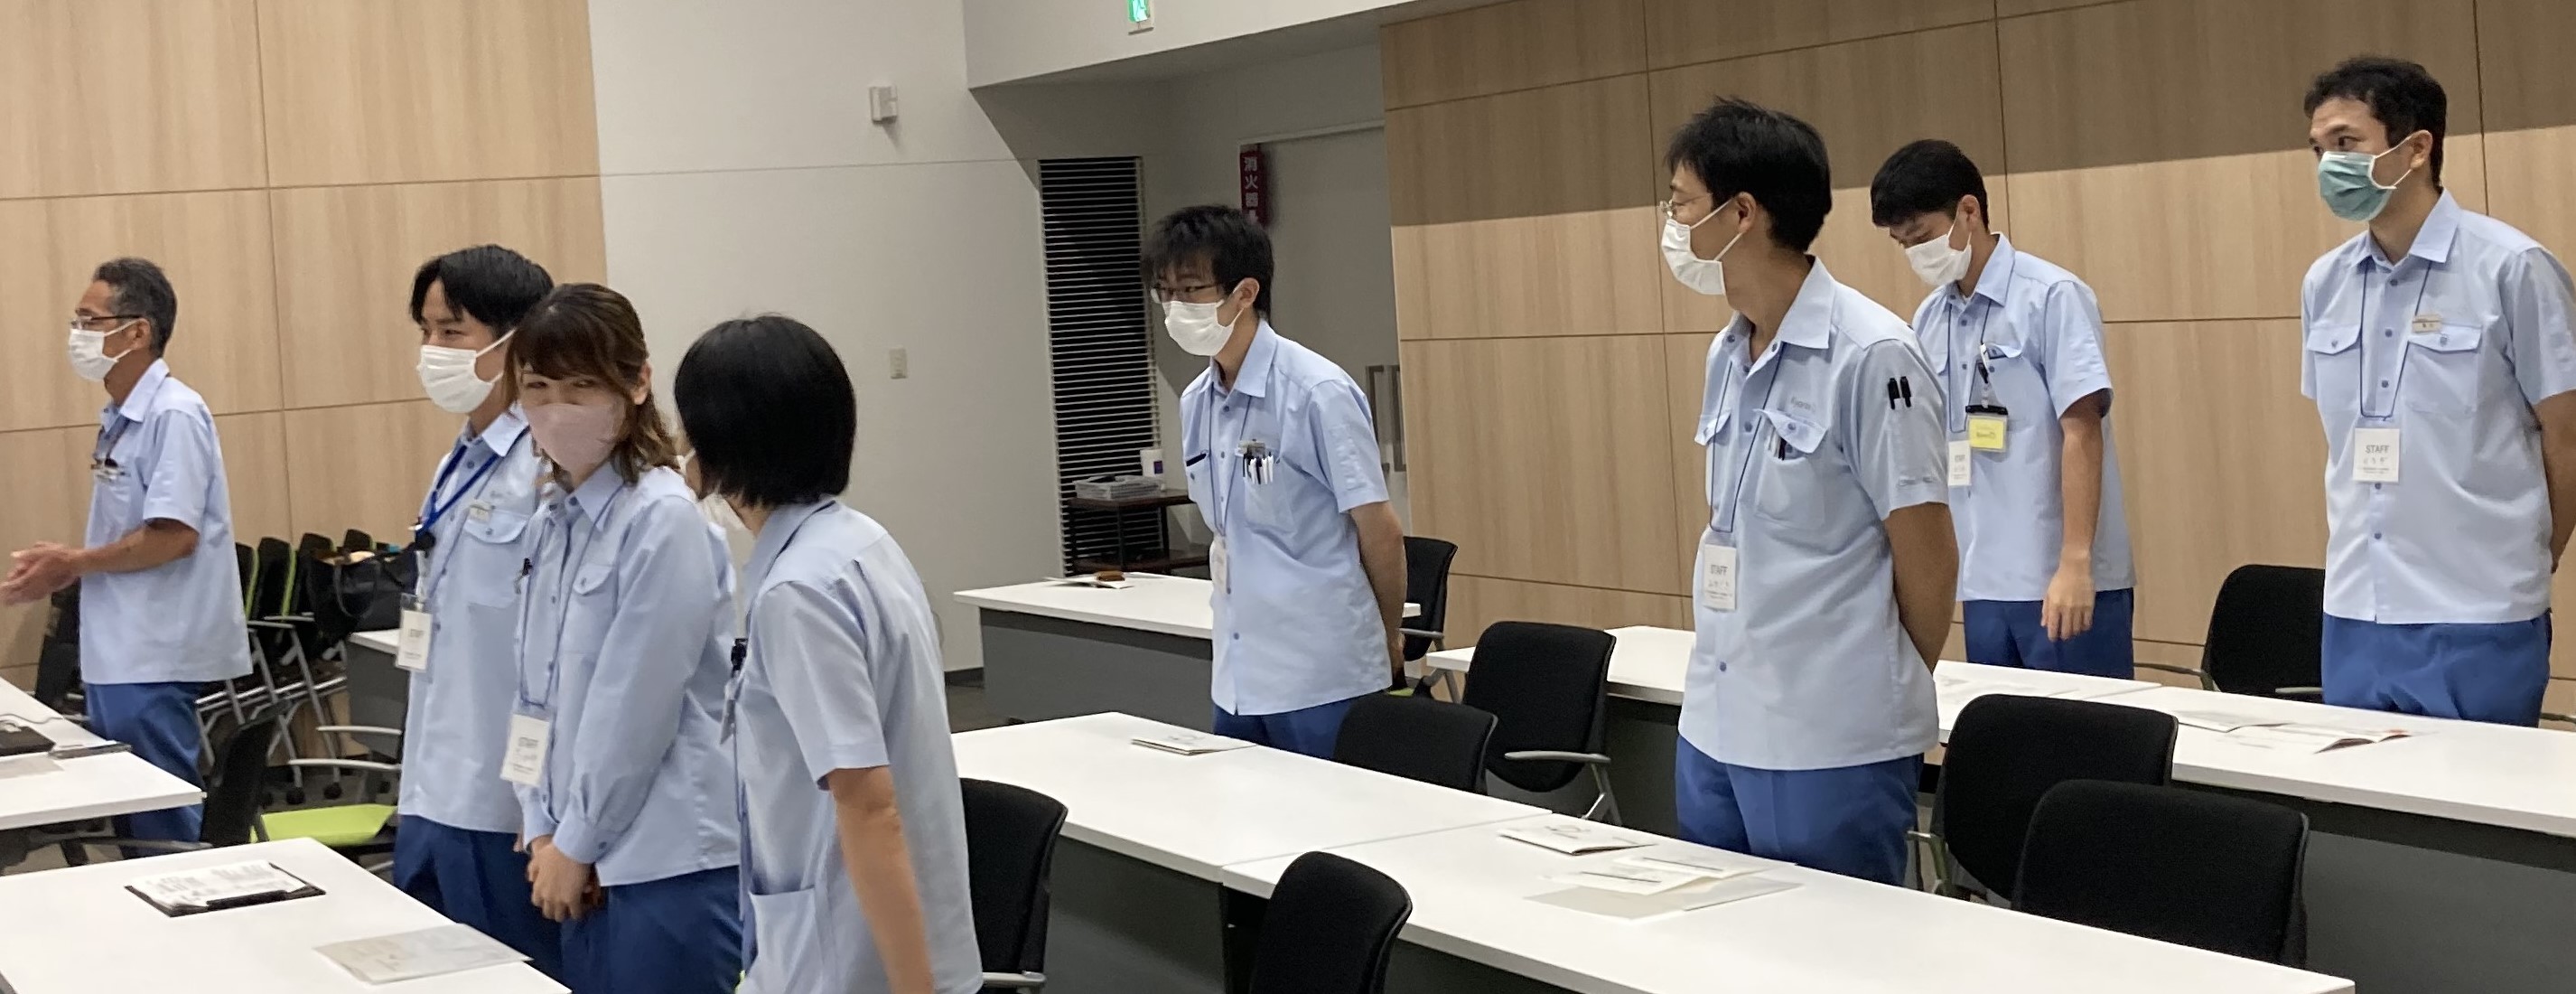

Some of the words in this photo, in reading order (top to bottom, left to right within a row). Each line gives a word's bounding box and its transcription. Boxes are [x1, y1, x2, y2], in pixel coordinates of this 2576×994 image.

[1244, 156, 1258, 207] 消火器
[2366, 445, 2390, 454] STAFF
